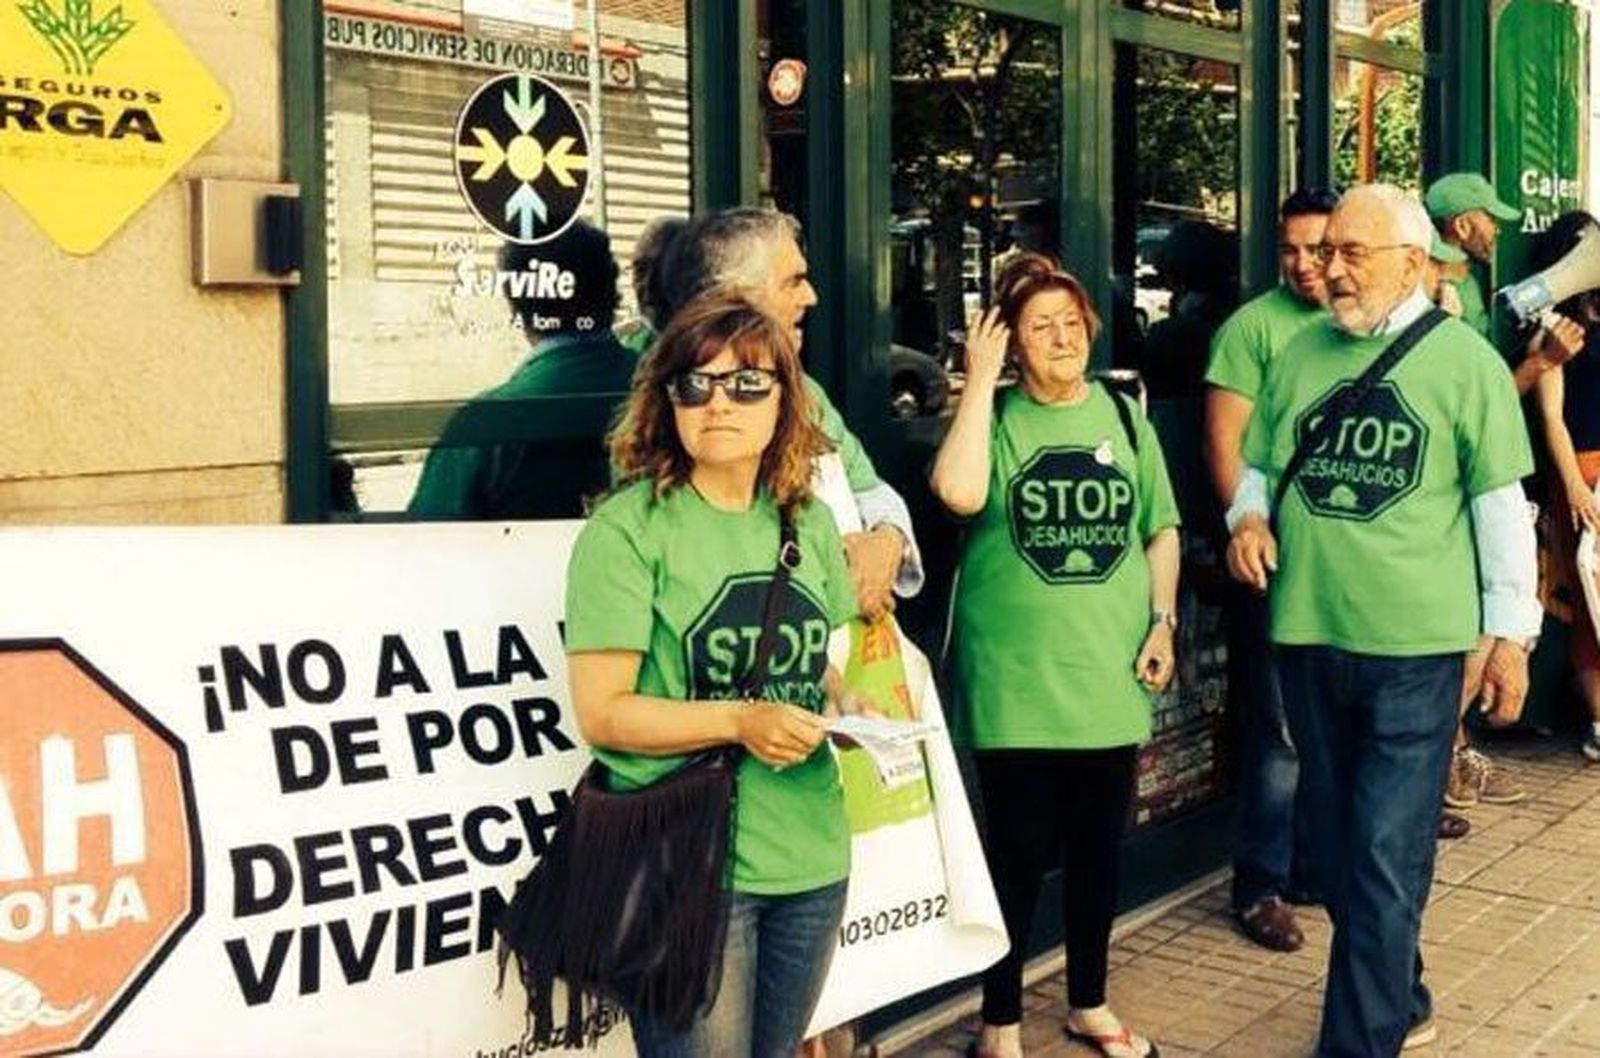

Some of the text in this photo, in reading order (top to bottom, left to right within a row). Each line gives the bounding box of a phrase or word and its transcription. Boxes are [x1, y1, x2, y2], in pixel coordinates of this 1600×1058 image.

[1021, 478, 1132, 522] STOP
[374, 634, 431, 698] A
[443, 625, 548, 690] LA
[270, 697, 578, 794] DE POR
[229, 789, 576, 919] DERECH
[0, 874, 151, 944] ORA
